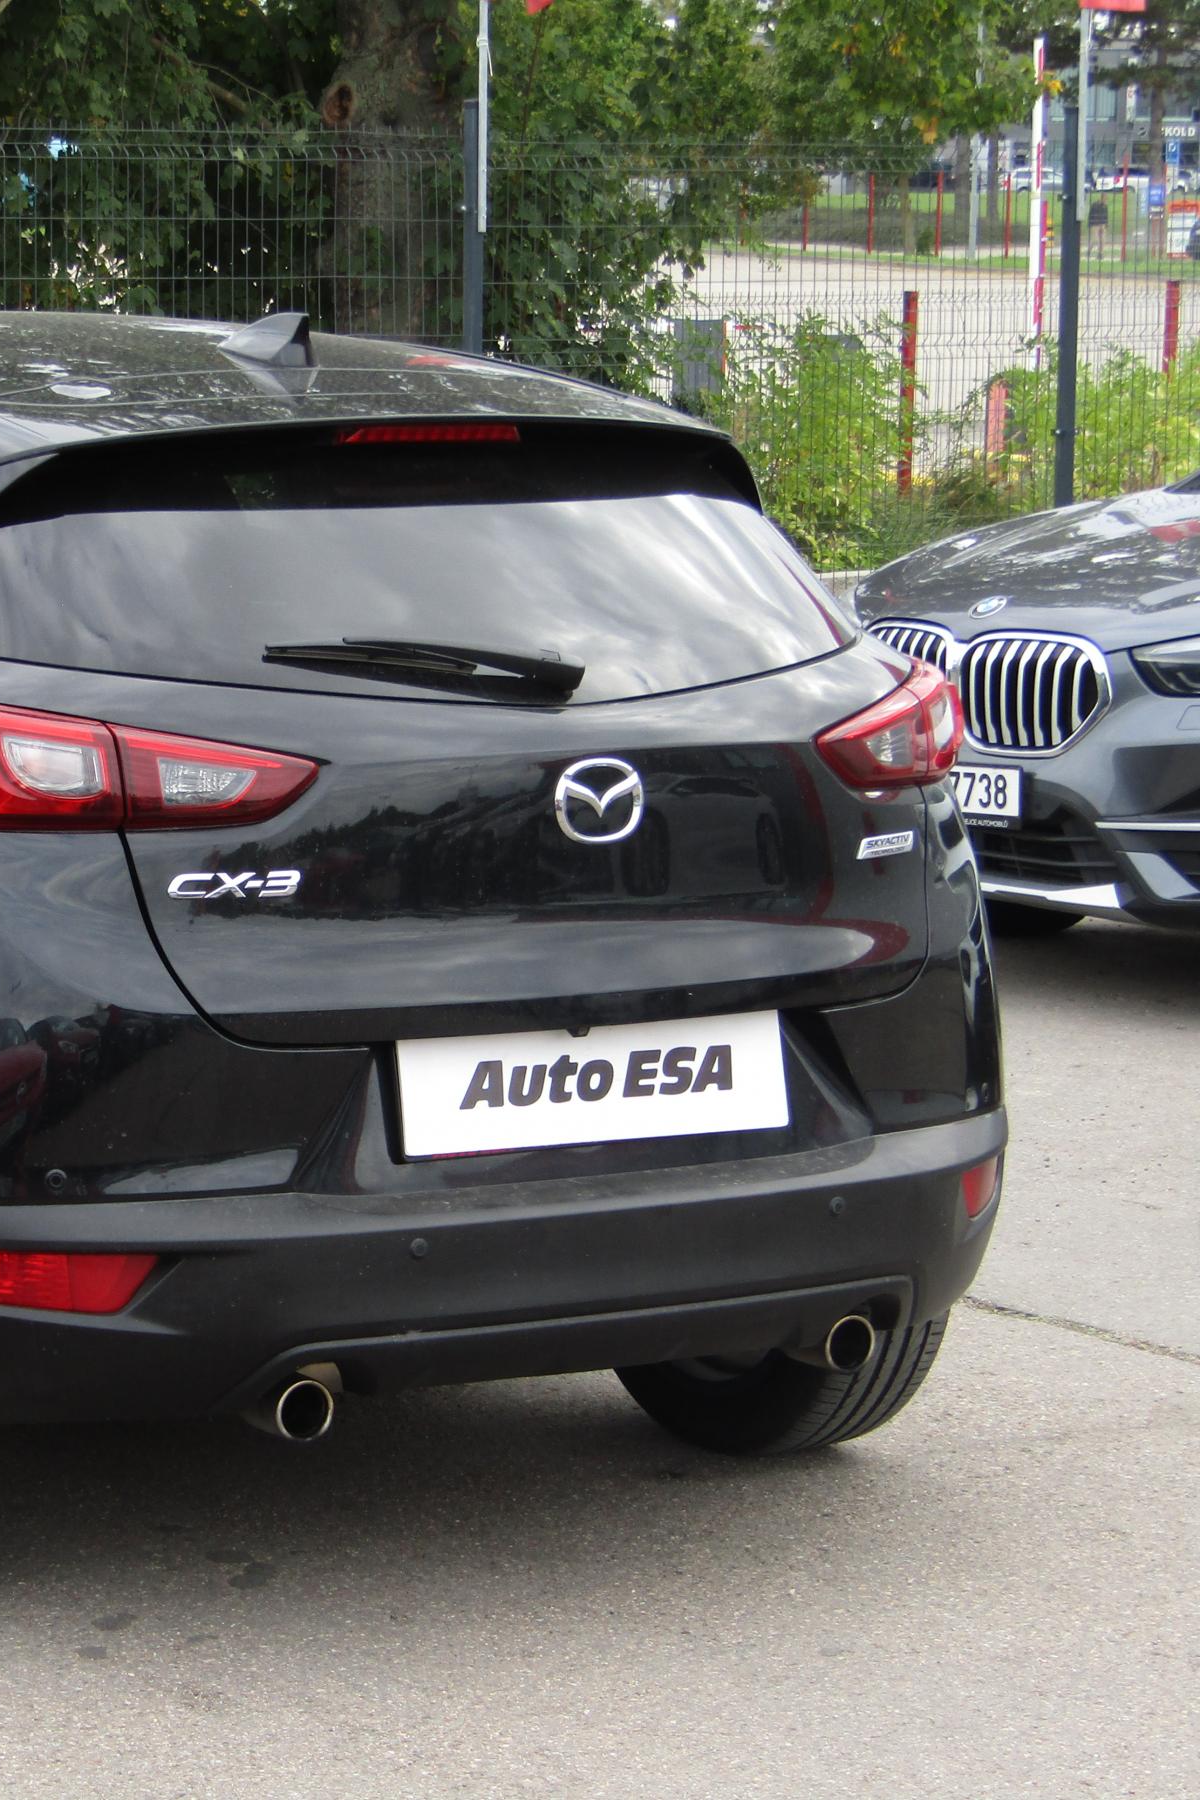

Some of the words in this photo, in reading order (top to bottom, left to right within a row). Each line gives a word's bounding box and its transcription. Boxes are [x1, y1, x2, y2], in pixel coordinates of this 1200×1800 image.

[866, 833, 911, 849] SKYACTIV
[167, 870, 301, 899] CX-3
[459, 1054, 614, 1110] Auto
[622, 1044, 733, 1098] ESA
